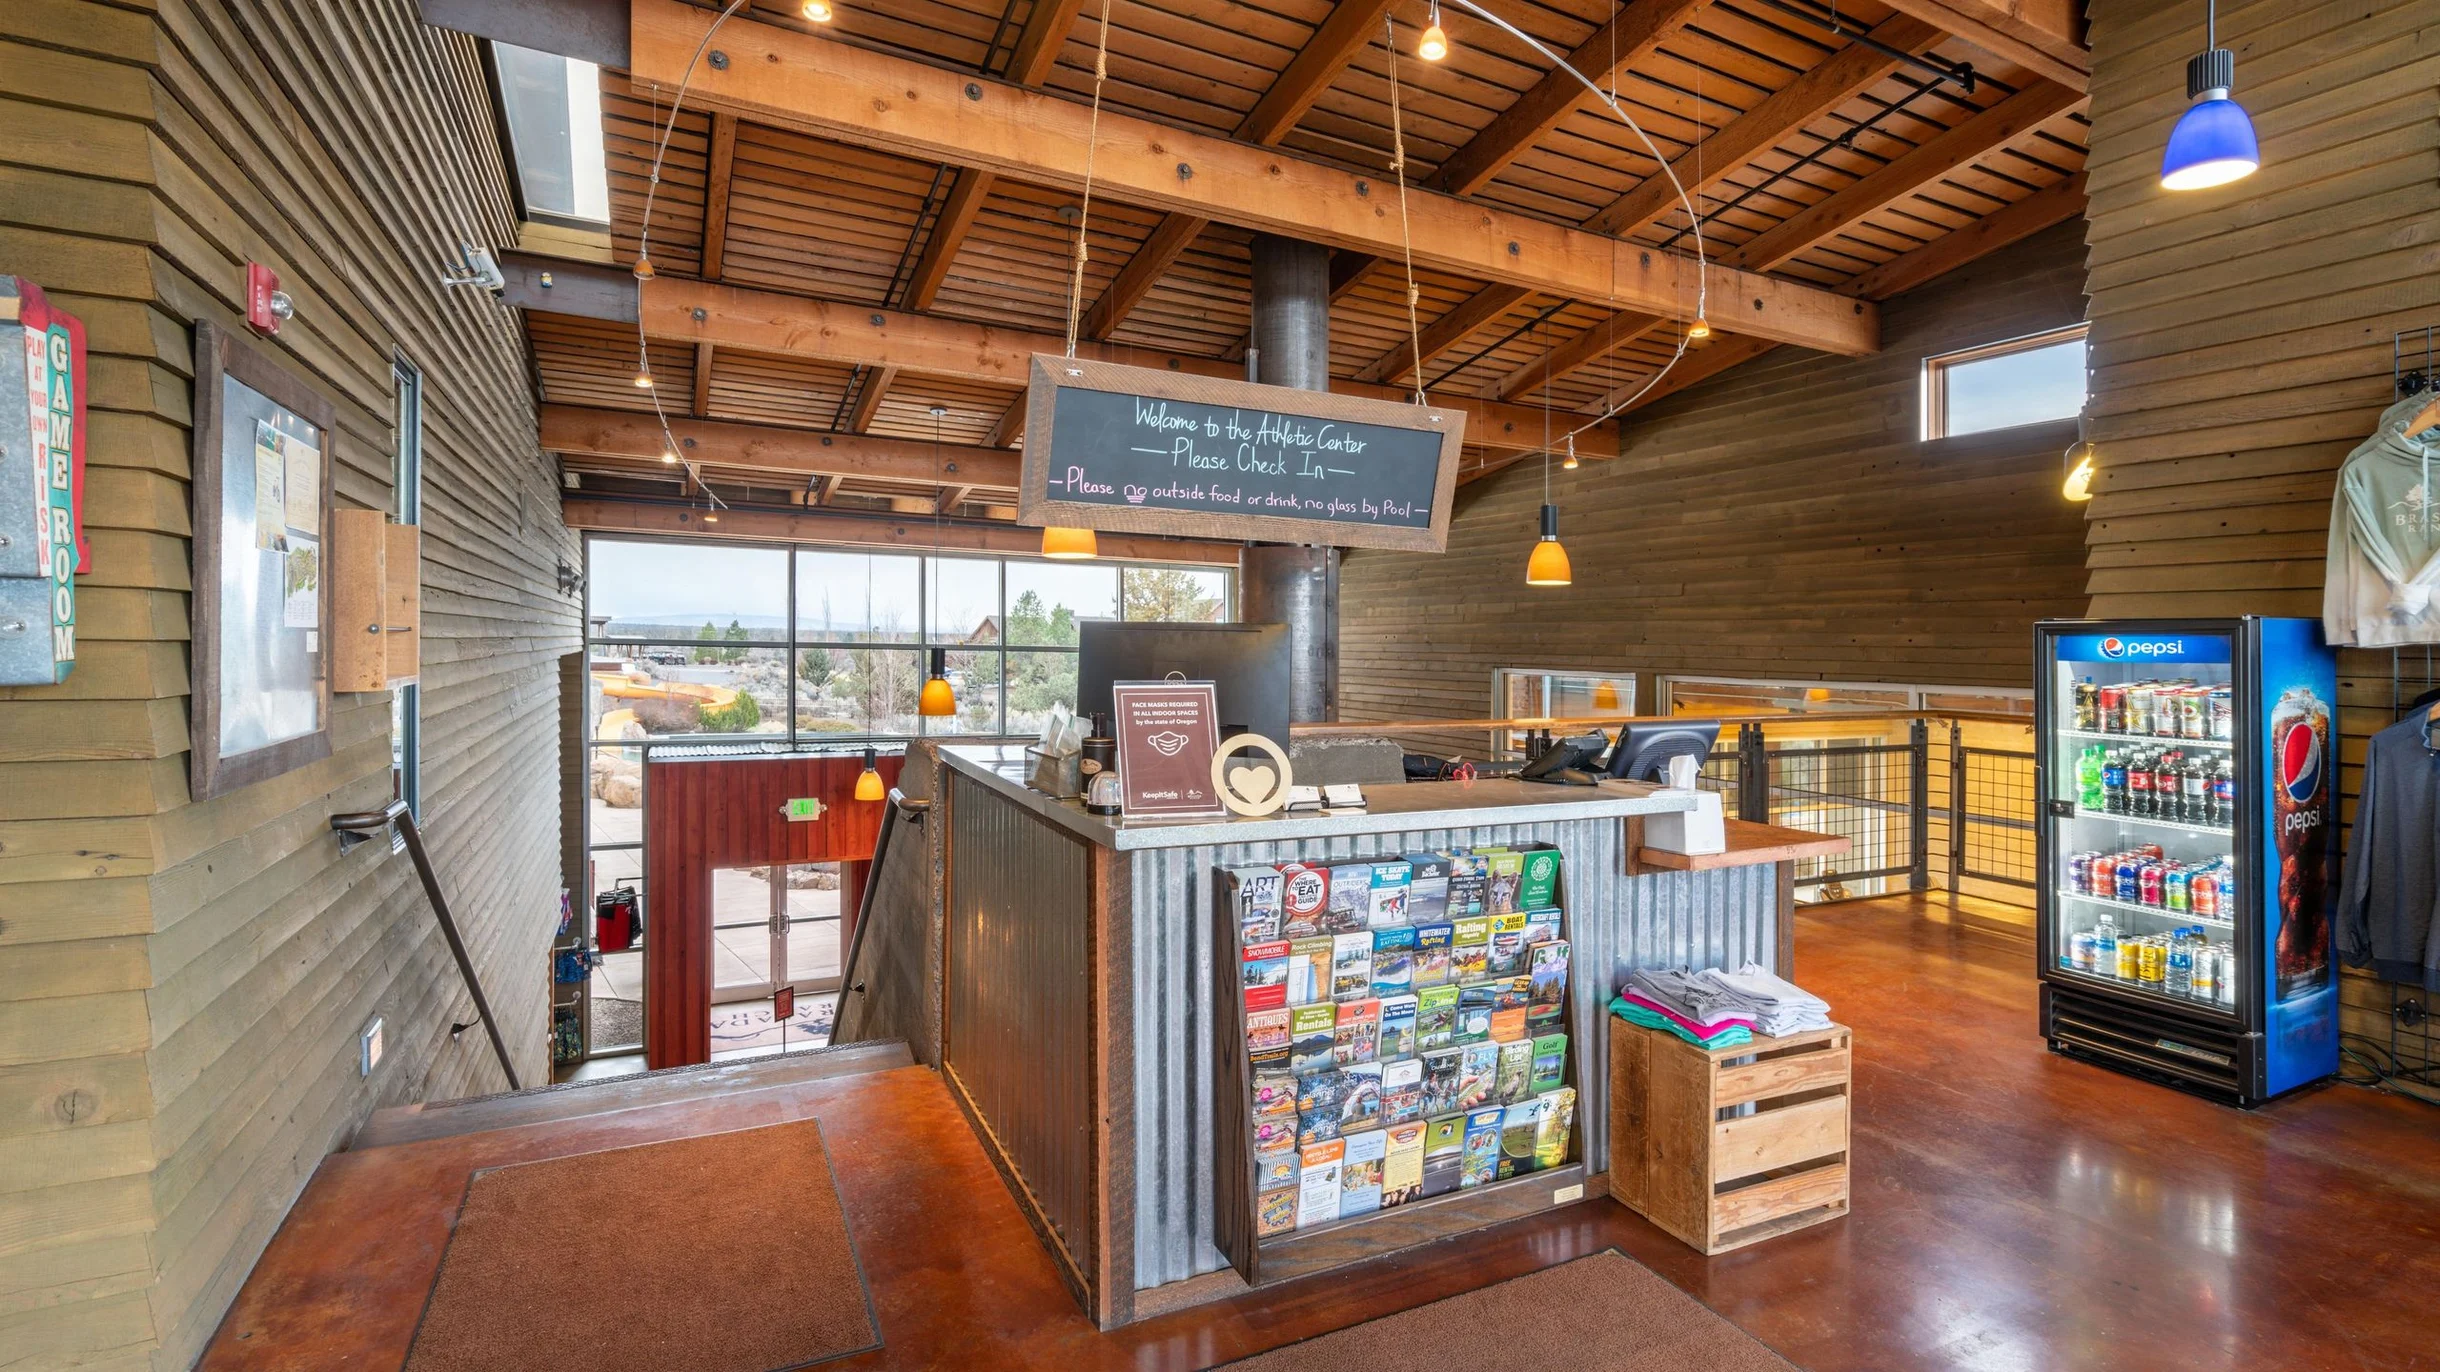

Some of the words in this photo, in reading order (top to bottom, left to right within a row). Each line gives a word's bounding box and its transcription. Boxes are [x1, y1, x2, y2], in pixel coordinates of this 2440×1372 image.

[27, 335, 45, 360] PLAY
[34, 365, 42, 382] AT
[30, 389, 47, 409] YOUR
[50, 333, 72, 490] GAME
[32, 417, 48, 433] OWN
[1136, 396, 1198, 433] Welcome
[1204, 416, 1220, 437] to
[1226, 409, 1252, 440] the
[1256, 413, 1314, 448] Athletic
[1318, 424, 1368, 454] Center
[1171, 436, 1230, 470] Please
[1238, 443, 1288, 475] Check
[1296, 451, 1324, 480] In
[1067, 466, 1114, 494] Please
[1124, 484, 1148, 497] no
[1152, 481, 1206, 500] outside
[1208, 484, 1240, 504] food
[1248, 494, 1264, 505] or
[1265, 492, 1302, 510] drink,
[1305, 500, 1324, 510] no
[1328, 498, 1356, 517] glass
[1362, 498, 1378, 520] by
[1384, 499, 1410, 518] Pool
[38, 443, 50, 565] RISK
[52, 507, 75, 662] ROOM
[2128, 640, 2184, 656] pepsi
[2285, 805, 2320, 836] pepsi
[1241, 876, 1280, 898] ART
[1294, 878, 1317, 886] WHERE
[1298, 885, 1320, 896] EAT
[1418, 928, 1451, 938] WHITEWATER
[1456, 922, 1486, 933] Rafting
[1504, 922, 1524, 930] RENTALS
[1248, 946, 1286, 958] SNOWMOBILE
[1292, 943, 1306, 951] Rock
[1308, 940, 1332, 950] Climbing
[1246, 1012, 1289, 1028] ANTIQUES
[1296, 1018, 1332, 1032] Rentals
[1542, 1042, 1558, 1050] Golf
[1478, 1051, 1493, 1061] FLY
